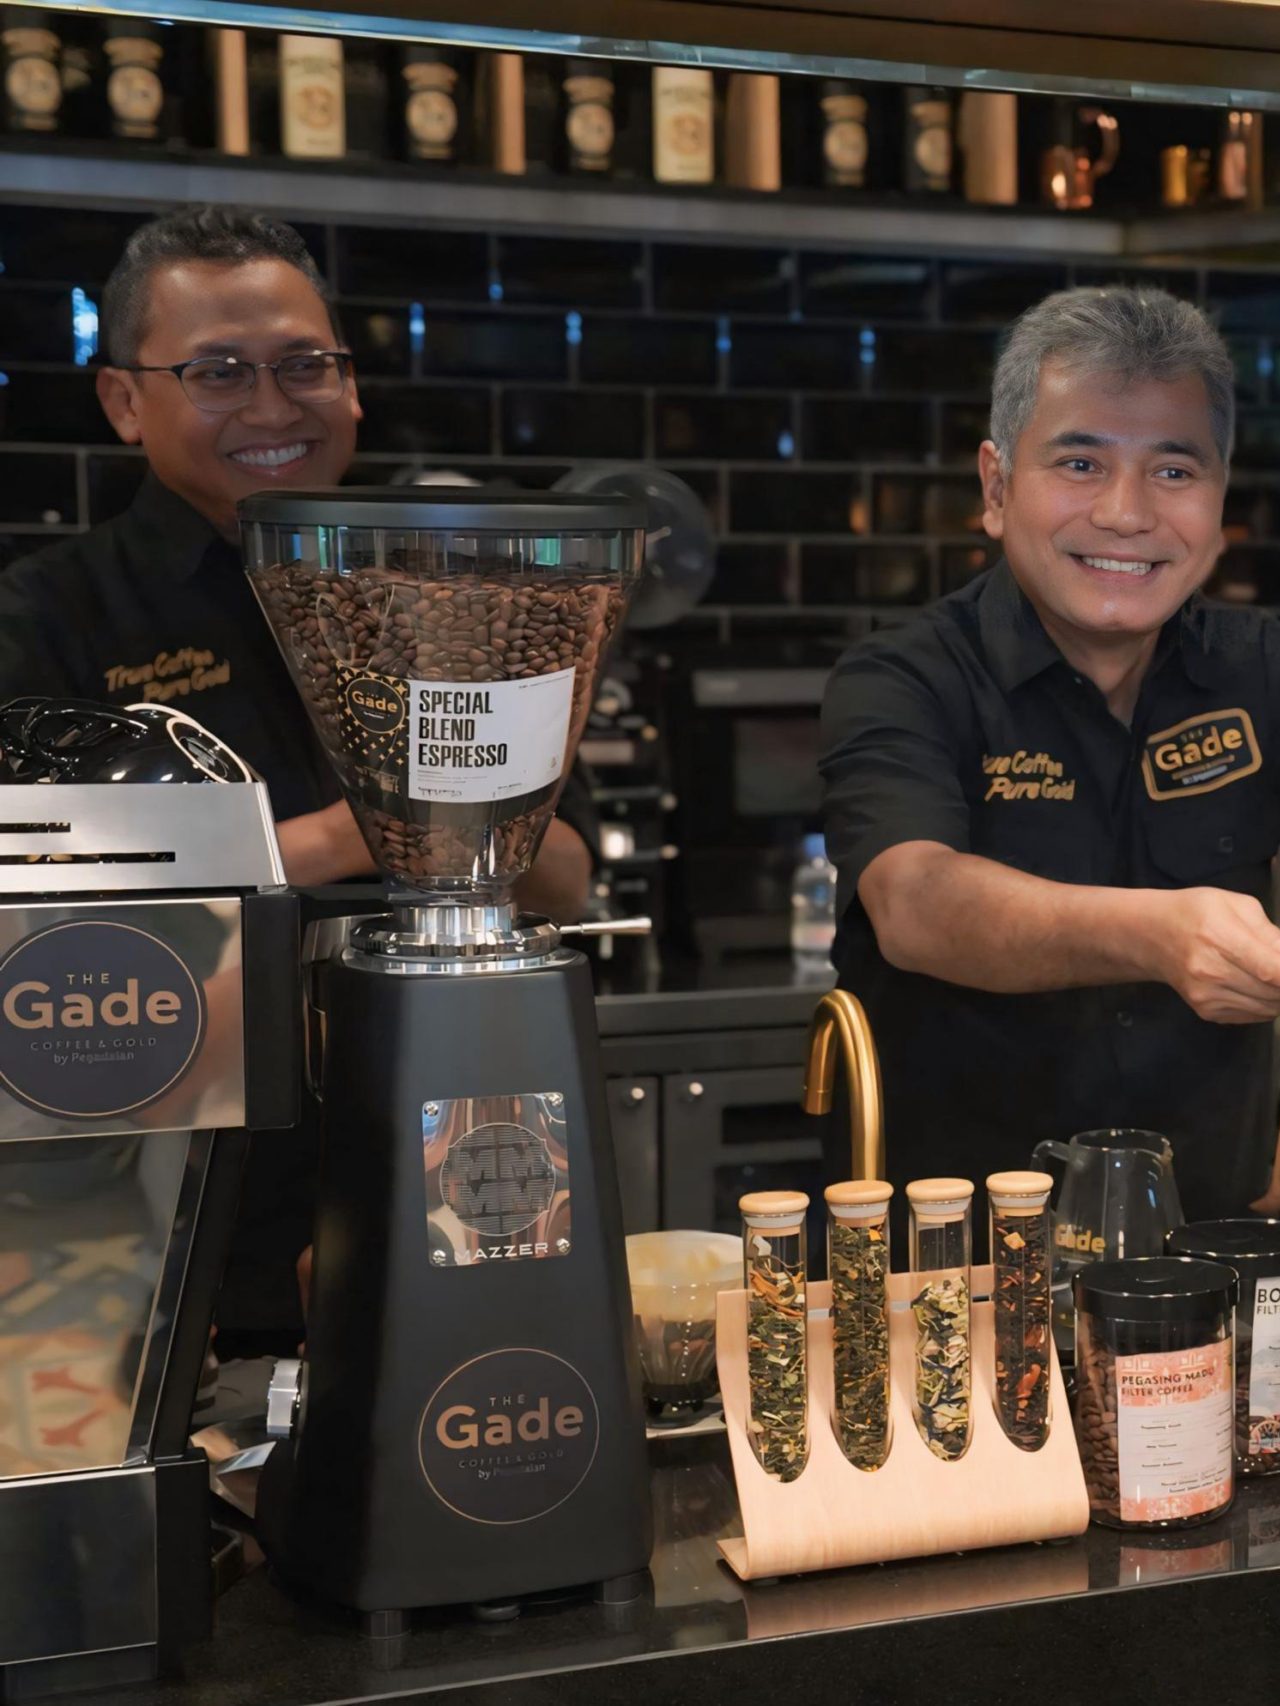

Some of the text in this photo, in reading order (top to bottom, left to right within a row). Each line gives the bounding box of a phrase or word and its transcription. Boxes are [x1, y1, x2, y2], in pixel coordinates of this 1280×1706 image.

[352, 690, 398, 713] Gade
[419, 689, 493, 715] SPECIAL
[418, 716, 475, 742] BLEND
[418, 742, 508, 768] ESPRESSO
[1154, 725, 1243, 772] Gade
[66, 972, 110, 985] THE
[3, 978, 182, 1030] Gade
[113, 1037, 158, 1048] GOLD
[53, 1053, 69, 1066] by
[1121, 1373, 1182, 1386] PEGASING
[1121, 1383, 1193, 1397] FILTER COFFEE
[489, 1394, 525, 1407] THE
[436, 1397, 584, 1450] Gade
[477, 1469, 491, 1481] by
